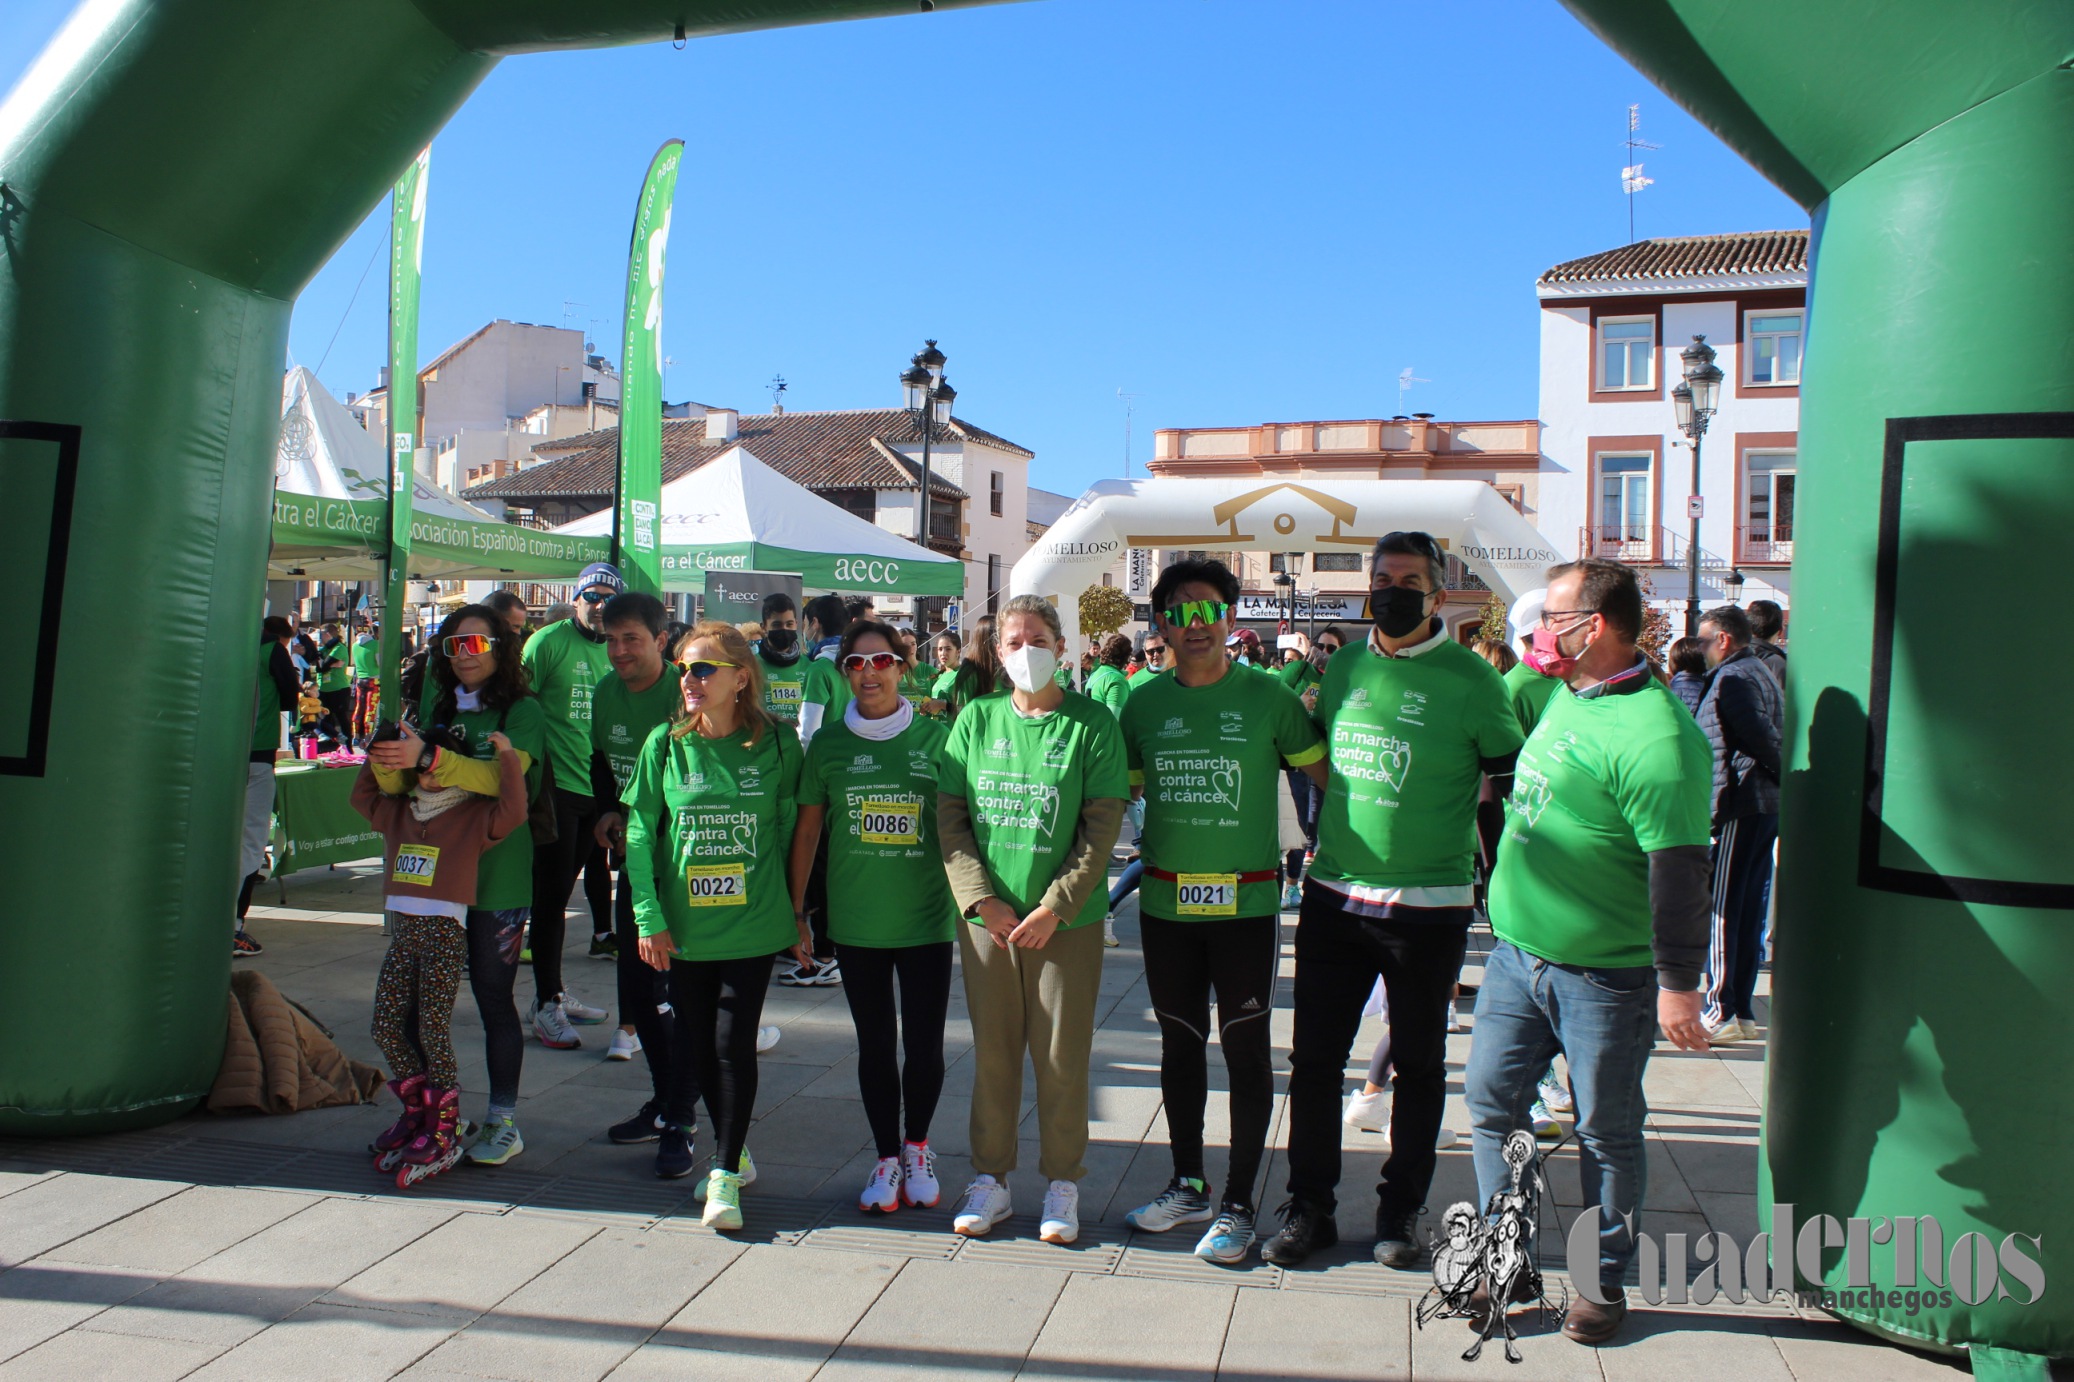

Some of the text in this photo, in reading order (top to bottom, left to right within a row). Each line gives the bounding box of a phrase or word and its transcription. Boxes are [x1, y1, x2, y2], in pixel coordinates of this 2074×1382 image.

[639, 184, 656, 241] digas
[656, 153, 677, 184] nada
[305, 500, 319, 528] el
[325, 503, 380, 534] Cáncer
[472, 526, 527, 556] Española
[529, 539, 564, 559] contra
[680, 551, 691, 569] el
[696, 551, 747, 569] Cáncer
[1041, 555, 1103, 564] AYUNTAMIENTO
[1460, 545, 1556, 562] TOMELLOSO
[834, 558, 899, 585] aecc
[1479, 560, 1542, 569] AYUNTAMIENTO
[578, 573, 616, 591] PUMA
[1132, 579, 1140, 591] LA
[728, 590, 758, 601] aecc
[1244, 597, 1258, 609] LA
[571, 688, 584, 698] En
[773, 688, 797, 699] 1184
[569, 710, 579, 720] el
[766, 703, 794, 711] contra
[1333, 727, 1410, 751] En marcha
[1333, 746, 1374, 763] contra
[1155, 755, 1240, 772] En marcha
[1159, 773, 1207, 787] contra
[1342, 763, 1393, 783] cáncer
[978, 776, 1058, 797] En marcha
[846, 790, 925, 807] En marcha
[976, 795, 1024, 812] contra
[1160, 788, 1229, 804] el cáncer
[678, 810, 758, 826] En marcha
[863, 813, 908, 834] 0086
[976, 809, 1045, 830] el cáncer
[680, 827, 728, 841] contra
[849, 822, 861, 836] el
[298, 840, 314, 852] Voy
[335, 833, 359, 845] contigo
[359, 830, 378, 841] donde
[695, 841, 746, 857] cáncer
[396, 855, 427, 874] 0037
[690, 876, 735, 896] 0022
[1179, 885, 1224, 904] 0021
